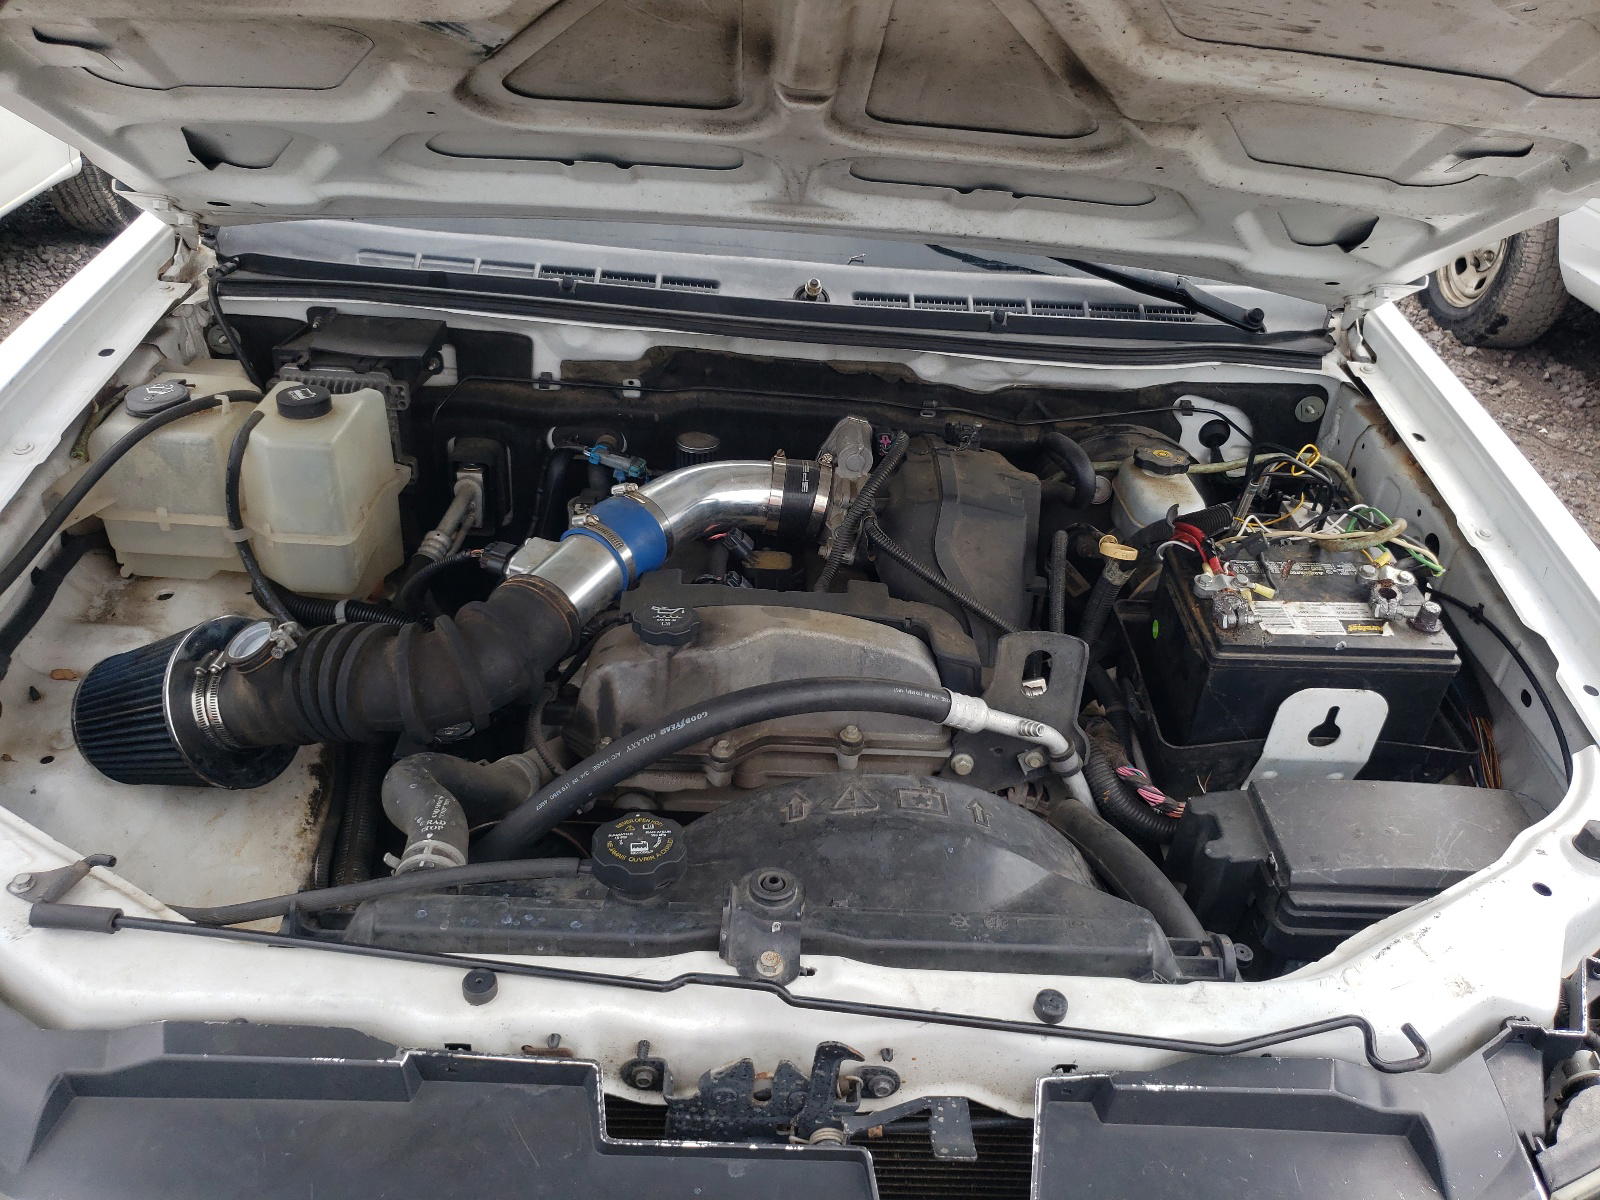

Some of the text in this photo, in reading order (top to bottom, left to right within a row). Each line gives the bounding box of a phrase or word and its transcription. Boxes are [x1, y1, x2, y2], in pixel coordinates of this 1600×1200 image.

[660, 711, 708, 735] GOODYEAR
[592, 759, 610, 771] HOSE
[615, 818, 634, 829] NEVER
[651, 819, 664, 827] HOT
